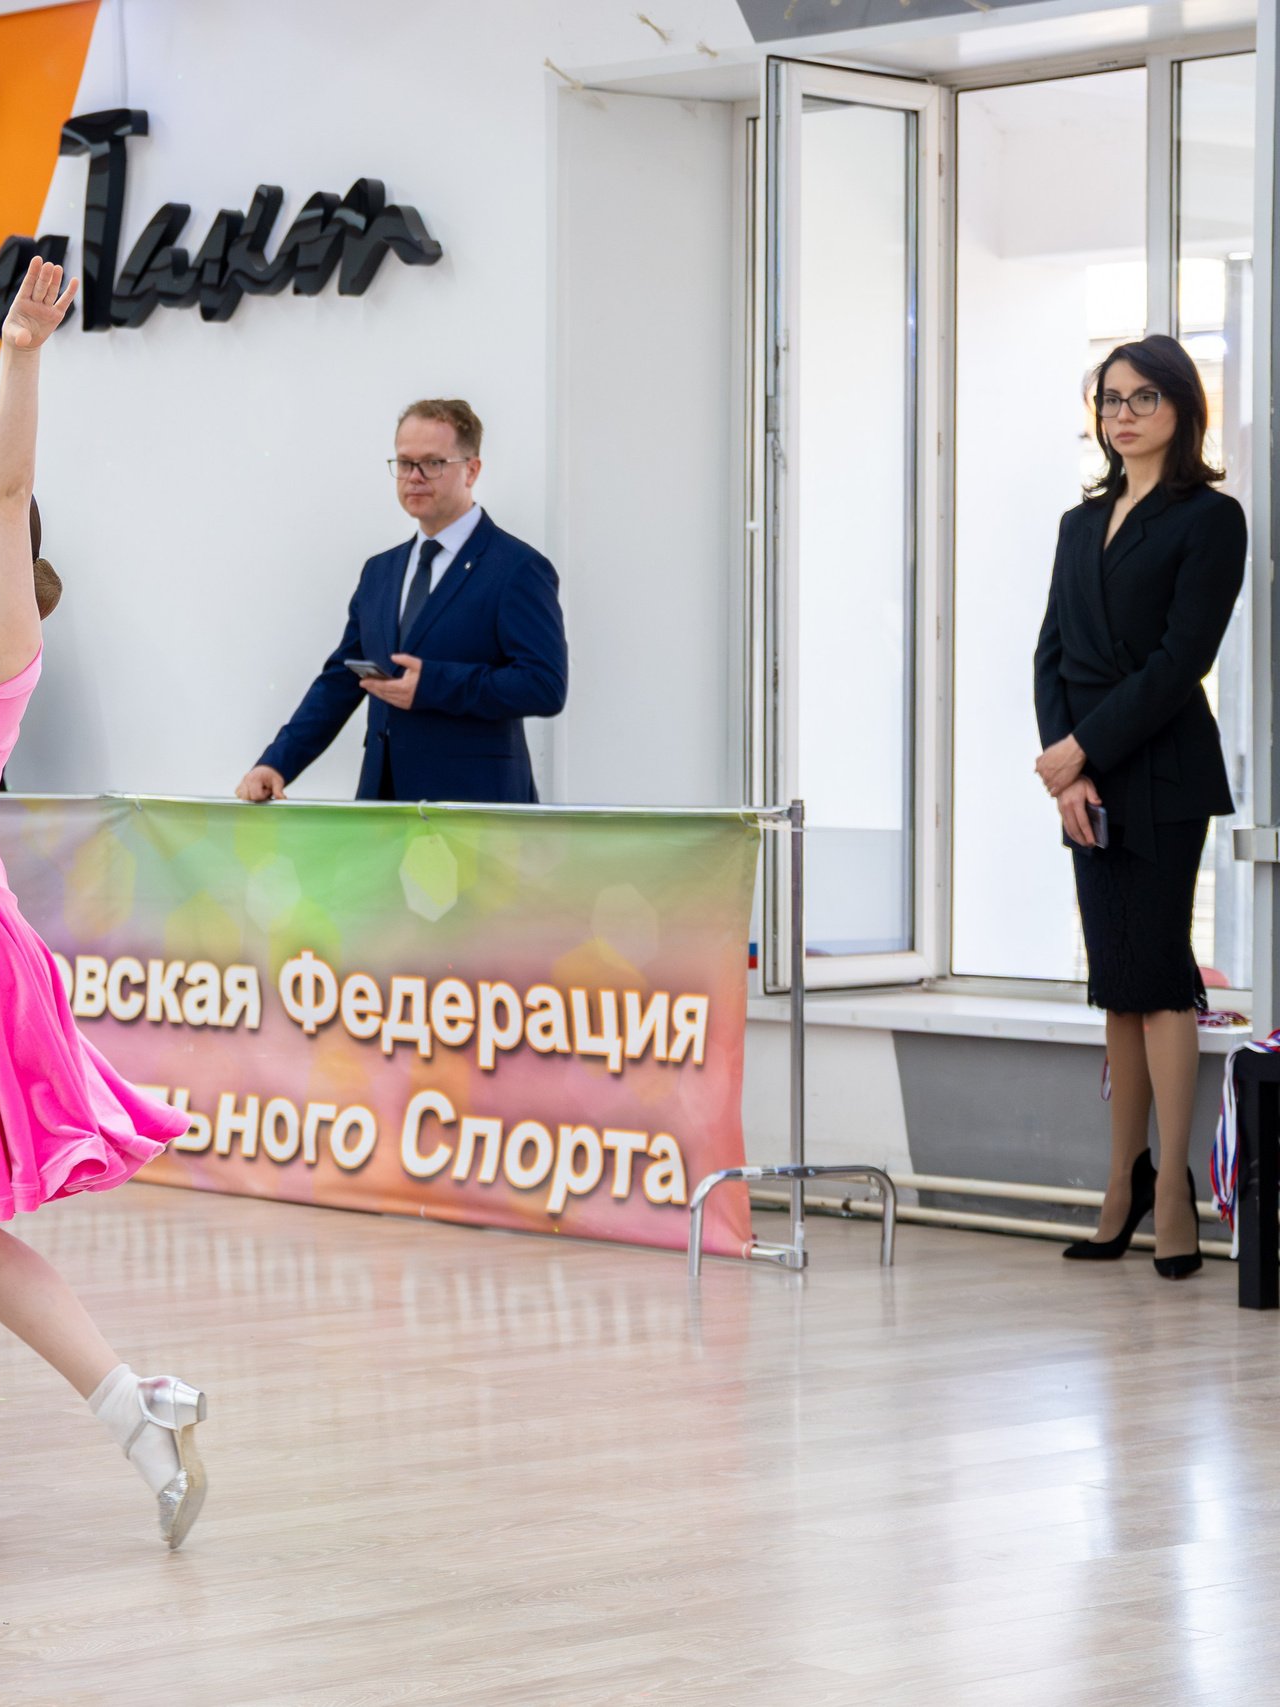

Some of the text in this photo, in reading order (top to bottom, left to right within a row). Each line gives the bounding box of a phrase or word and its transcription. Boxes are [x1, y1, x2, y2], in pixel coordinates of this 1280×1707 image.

[54, 949, 710, 1073] вская Федерация
[136, 1083, 688, 1214] ьного Спорта
